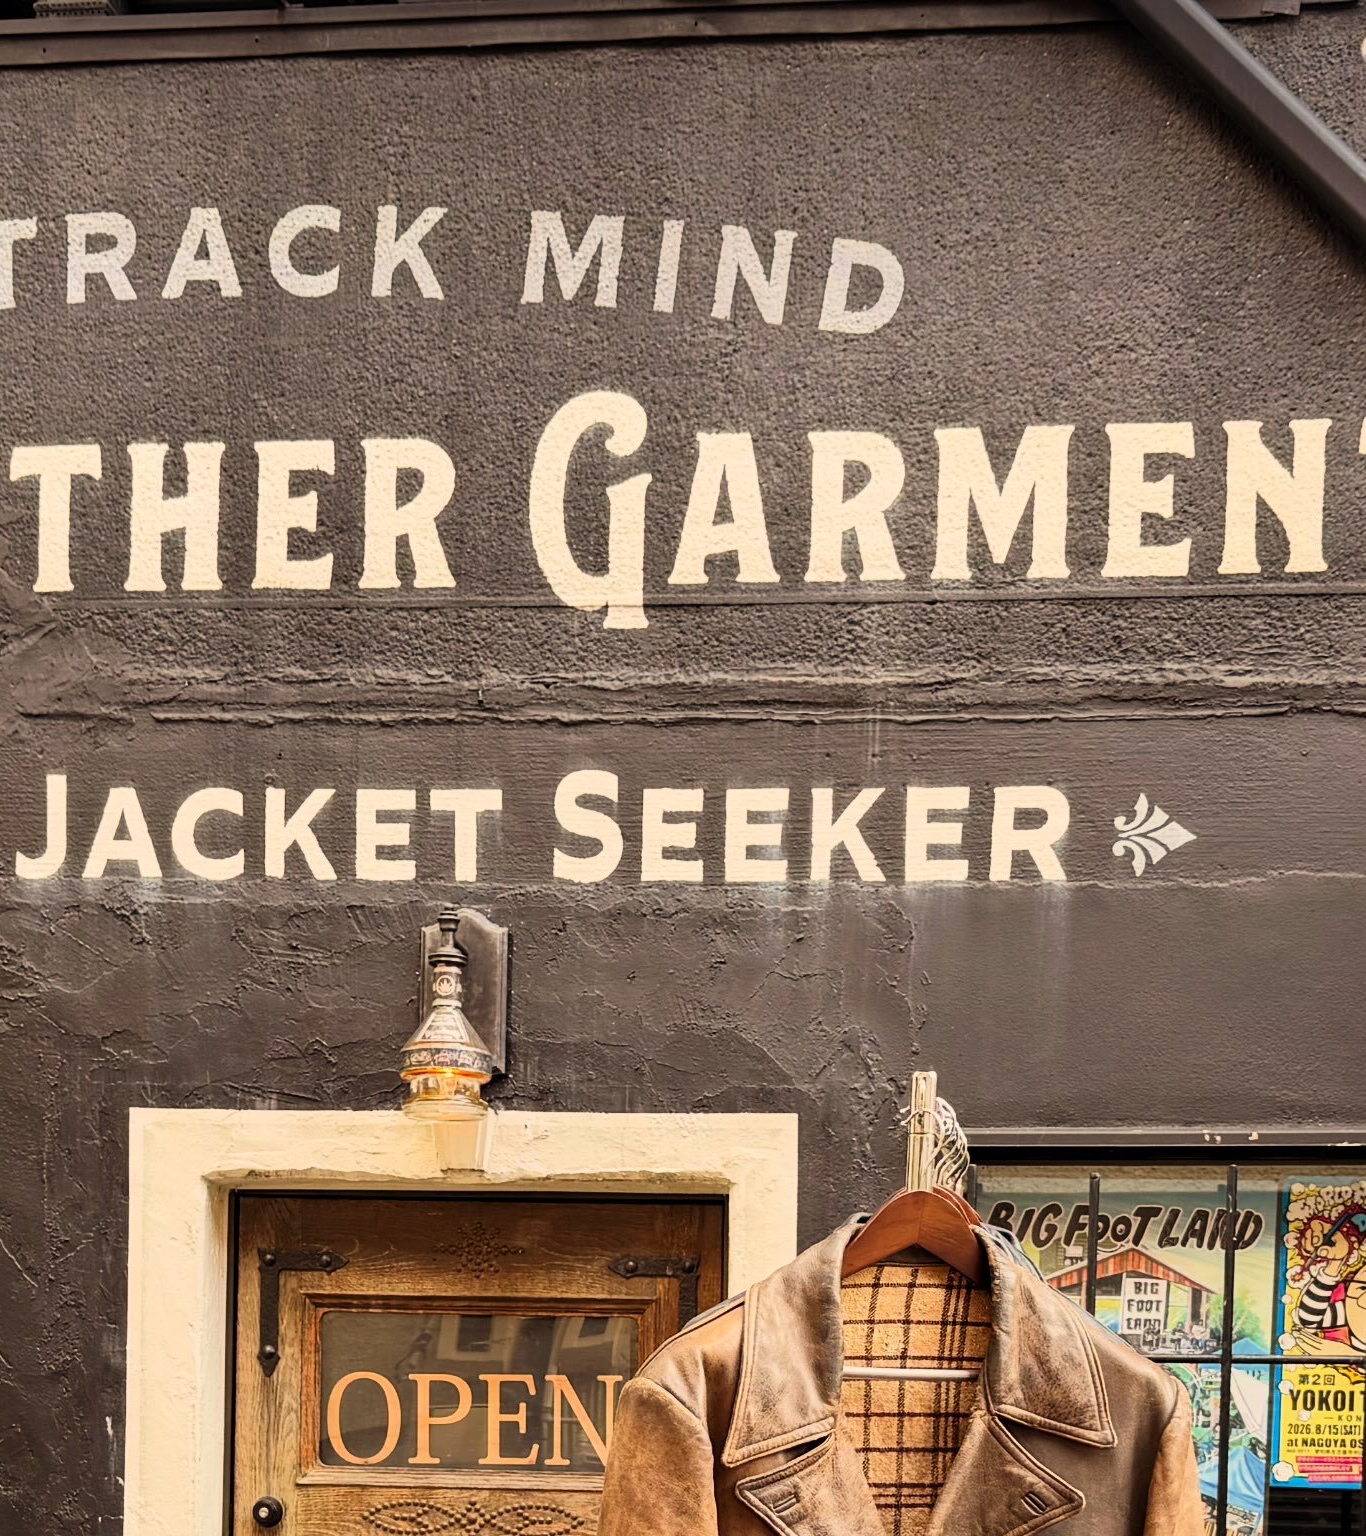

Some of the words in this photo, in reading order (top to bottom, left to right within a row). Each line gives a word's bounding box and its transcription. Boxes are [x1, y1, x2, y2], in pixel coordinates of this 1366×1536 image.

[521, 211, 905, 335] MIND
[15, 775, 502, 881] JACKET
[553, 770, 1070, 883] SEEKER
[987, 1201, 1063, 1248] BIG
[1157, 1208, 1265, 1251] LAND
[1134, 1282, 1160, 1295] BIG
[1127, 1299, 1162, 1312] FOOT
[1298, 1374, 1335, 1386] 第2回
[1289, 1389, 1355, 1412] YOKOI
[327, 1371, 624, 1466] OPEN
[1287, 1439, 1299, 1447] at
[1301, 1438, 1347, 1449] NAGOYA
